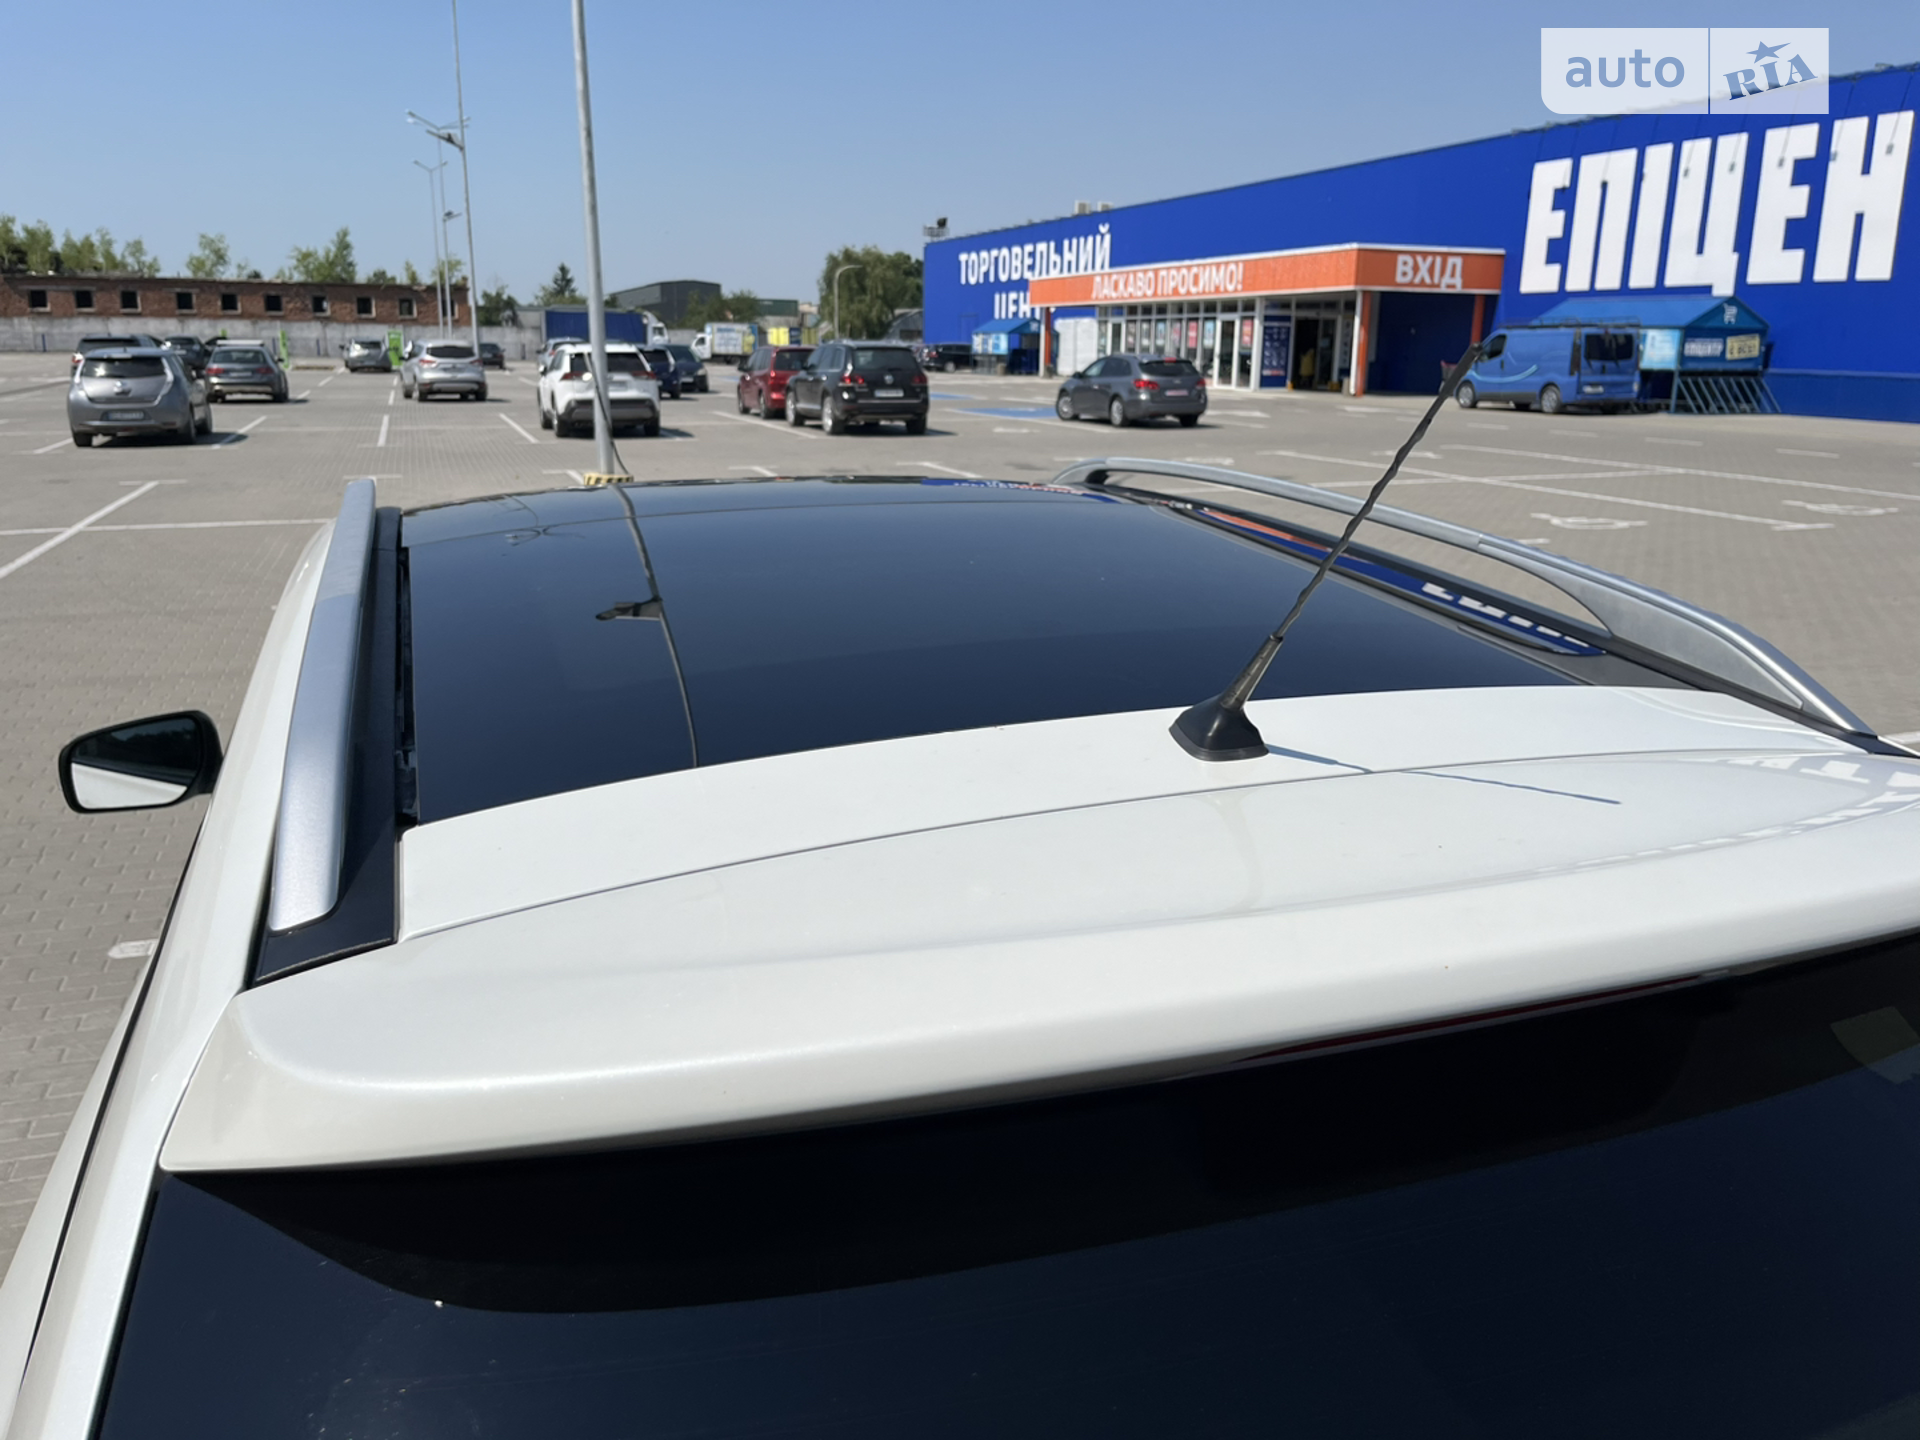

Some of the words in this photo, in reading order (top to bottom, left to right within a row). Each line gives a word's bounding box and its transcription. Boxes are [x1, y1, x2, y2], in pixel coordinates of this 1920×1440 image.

[1519, 110, 1915, 297] ЕПІЦЕН
[958, 223, 1112, 286] ТОРГОВЕЛЬНИЙ
[1395, 253, 1463, 291] ВХІД
[1091, 268, 1156, 300] ЛАСКАВО
[1157, 261, 1244, 297] ПРОСИМО!
